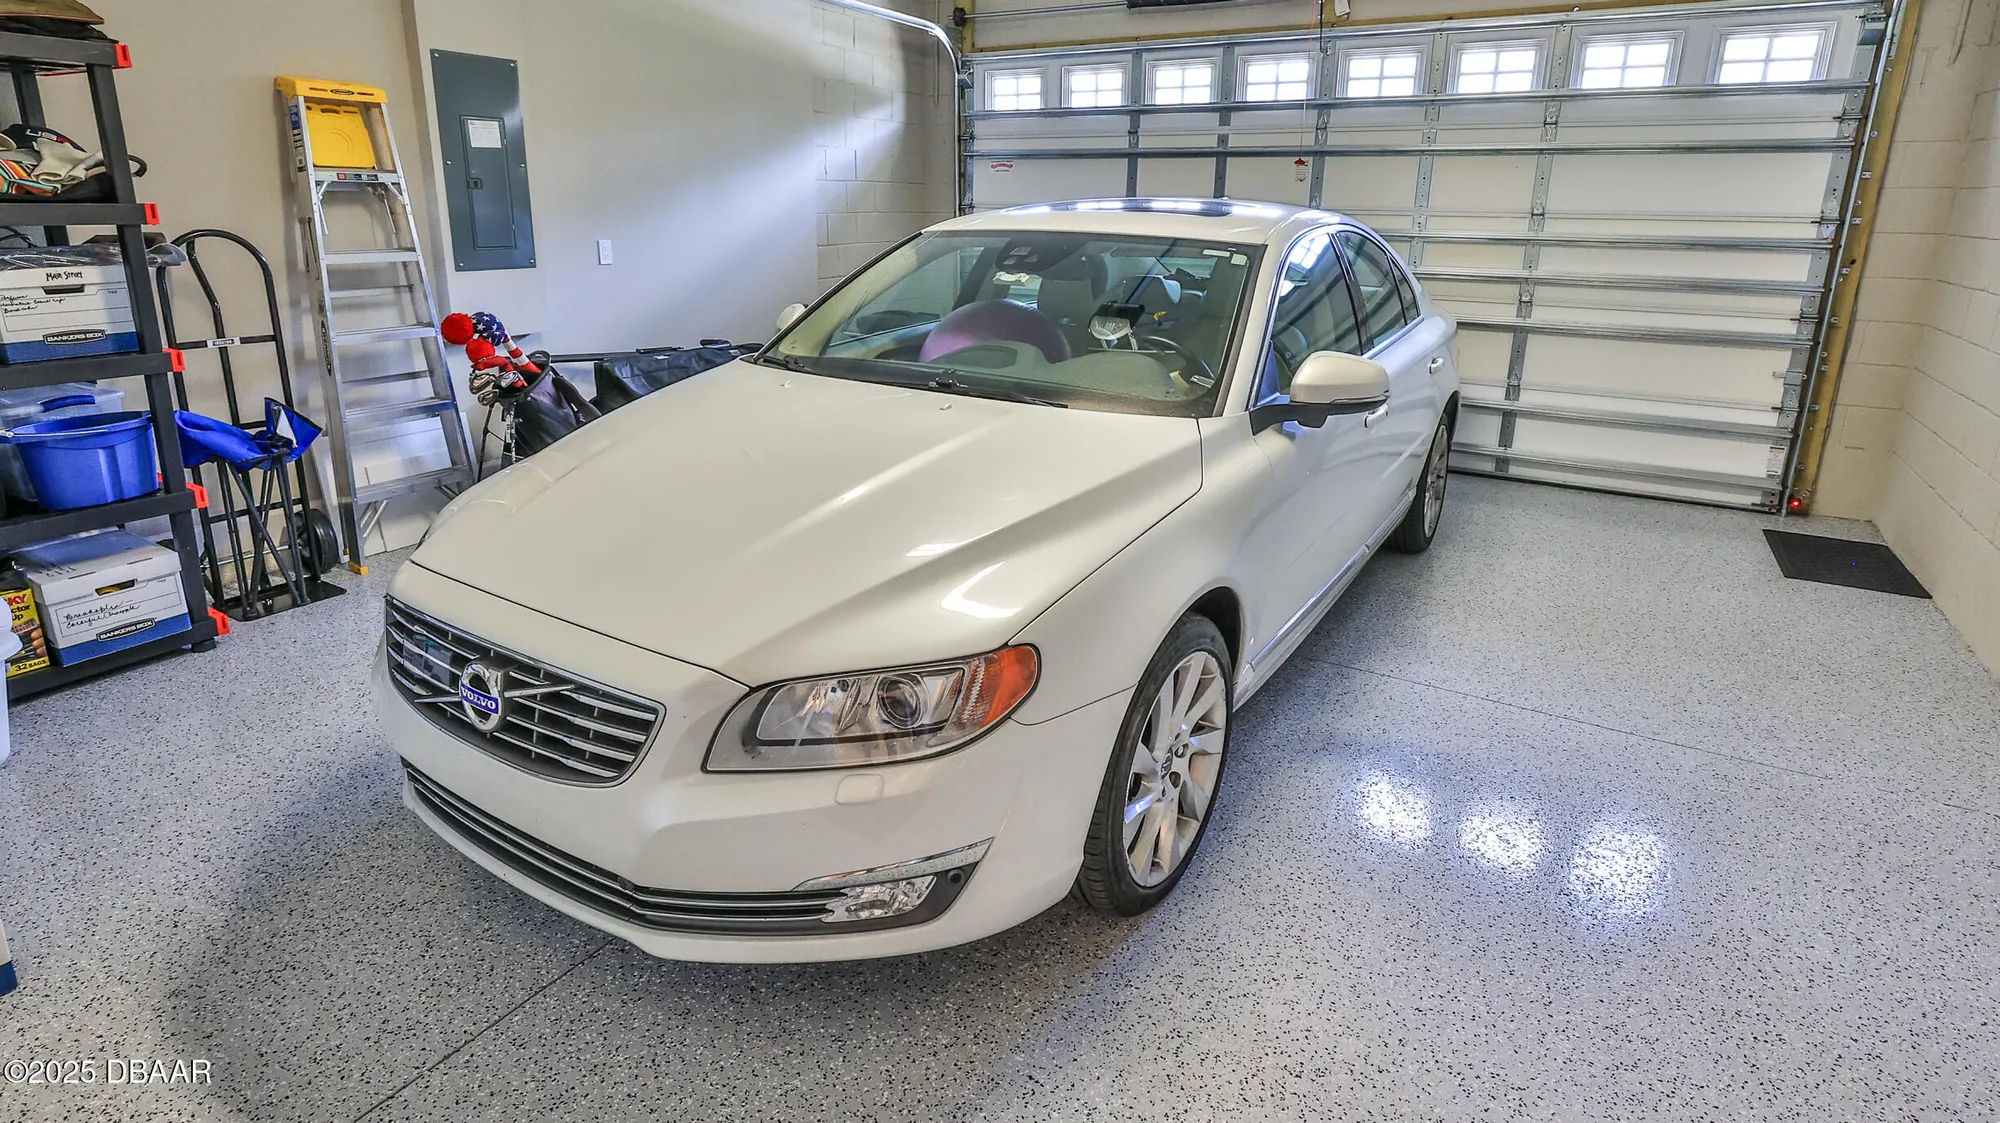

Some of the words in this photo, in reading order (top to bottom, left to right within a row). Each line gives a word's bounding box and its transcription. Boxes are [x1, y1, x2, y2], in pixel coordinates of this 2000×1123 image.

[47, 334, 86, 342] BANKERS
[100, 625, 136, 639] BANKERS
[136, 620, 153, 629] BOX
[15, 663, 28, 672] 32
[28, 659, 46, 668] BAGS
[461, 686, 497, 710] VOLVO
